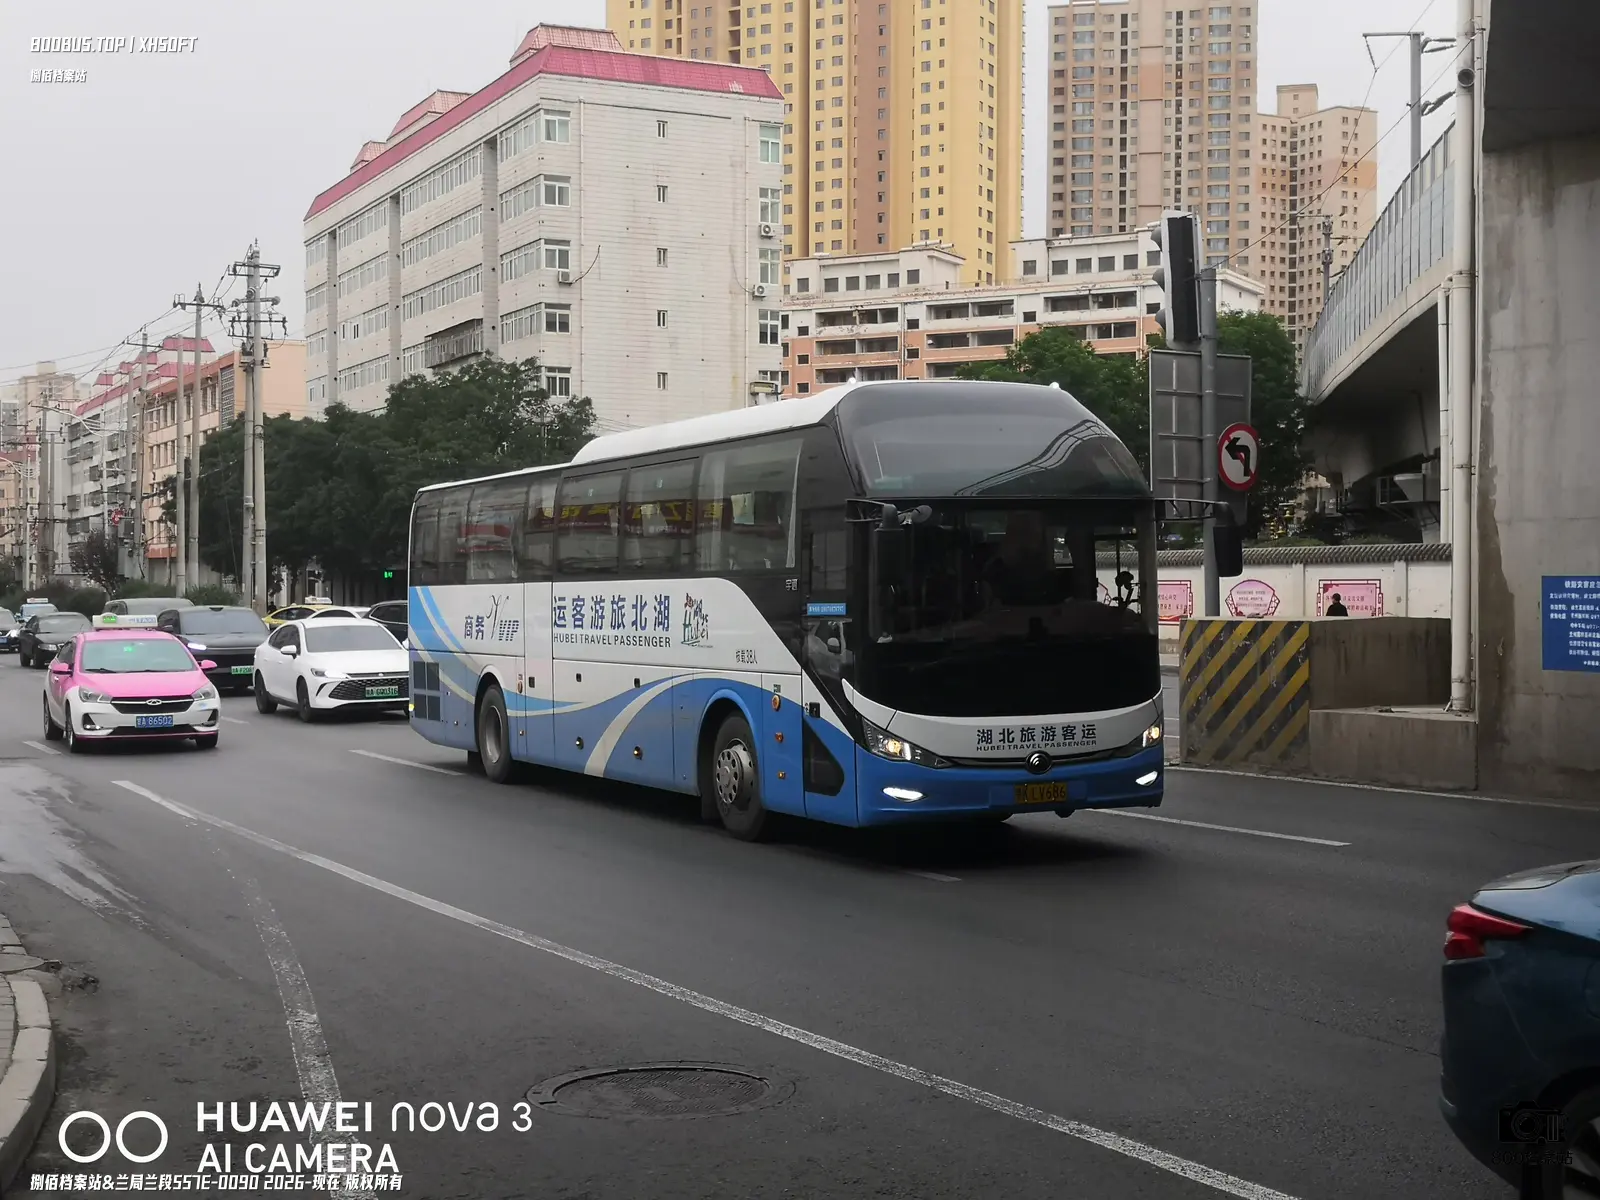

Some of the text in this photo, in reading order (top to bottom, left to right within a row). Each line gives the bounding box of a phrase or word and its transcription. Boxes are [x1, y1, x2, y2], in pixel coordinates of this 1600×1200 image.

[464, 615, 520, 641] 商务 VIP
[553, 633, 671, 648] HUBEI TRAVEL PASSENGER
[976, 723, 1097, 745] 湖北旅游客运
[976, 744, 1005, 752] HUBEI
[1044, 740, 1097, 749] PASSENGER
